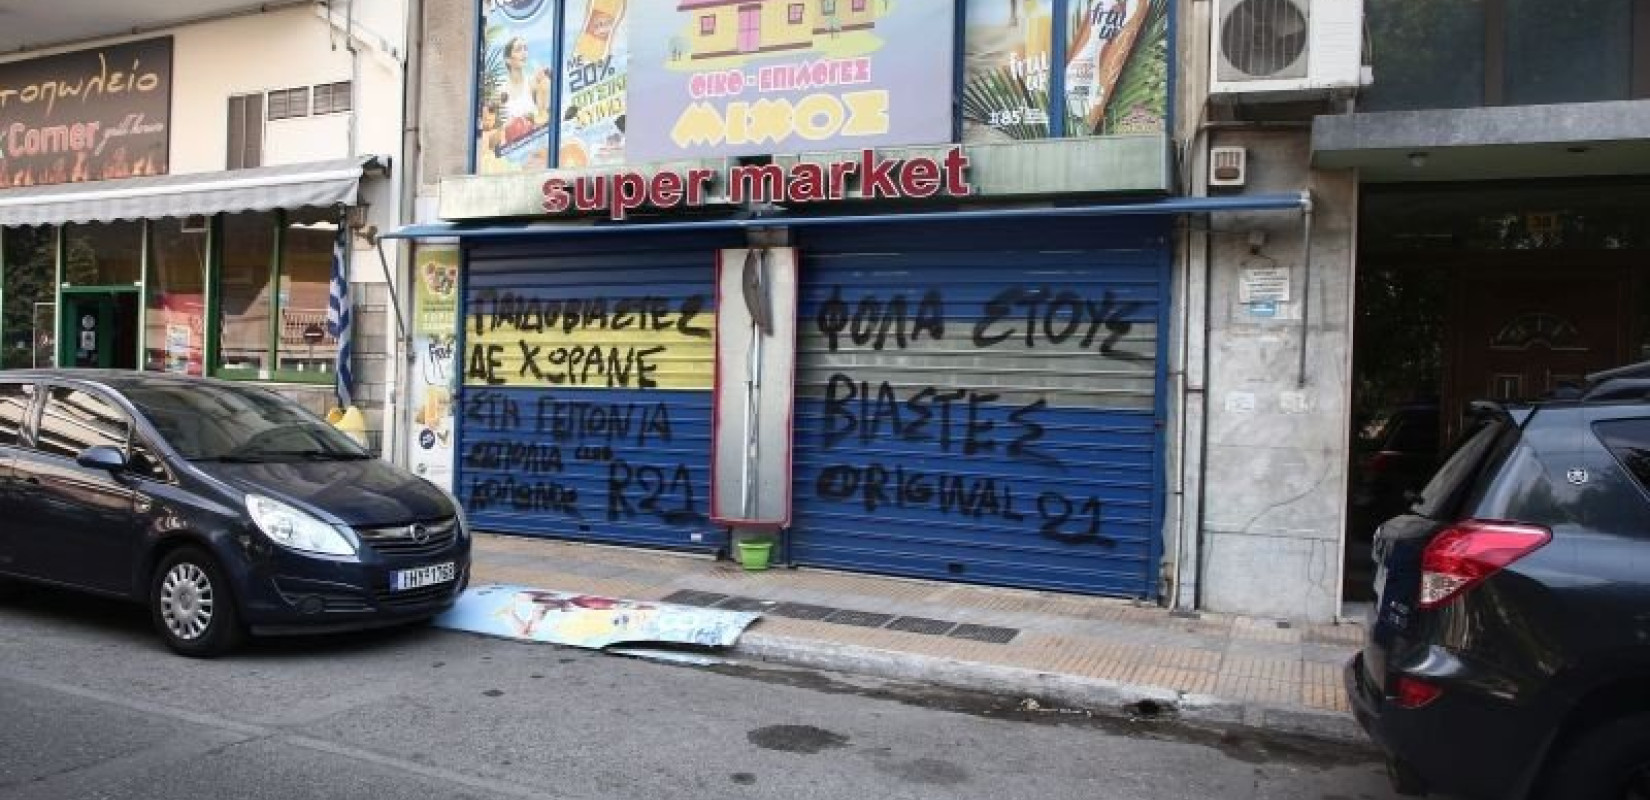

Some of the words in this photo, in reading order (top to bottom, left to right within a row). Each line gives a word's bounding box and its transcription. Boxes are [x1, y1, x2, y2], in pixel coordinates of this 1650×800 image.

[568, 54, 616, 93] 20%
[541, 167, 716, 220] super
[728, 145, 970, 203] market
[817, 284, 945, 351] ΦΟΛΑ
[1037, 491, 1117, 549] 21
